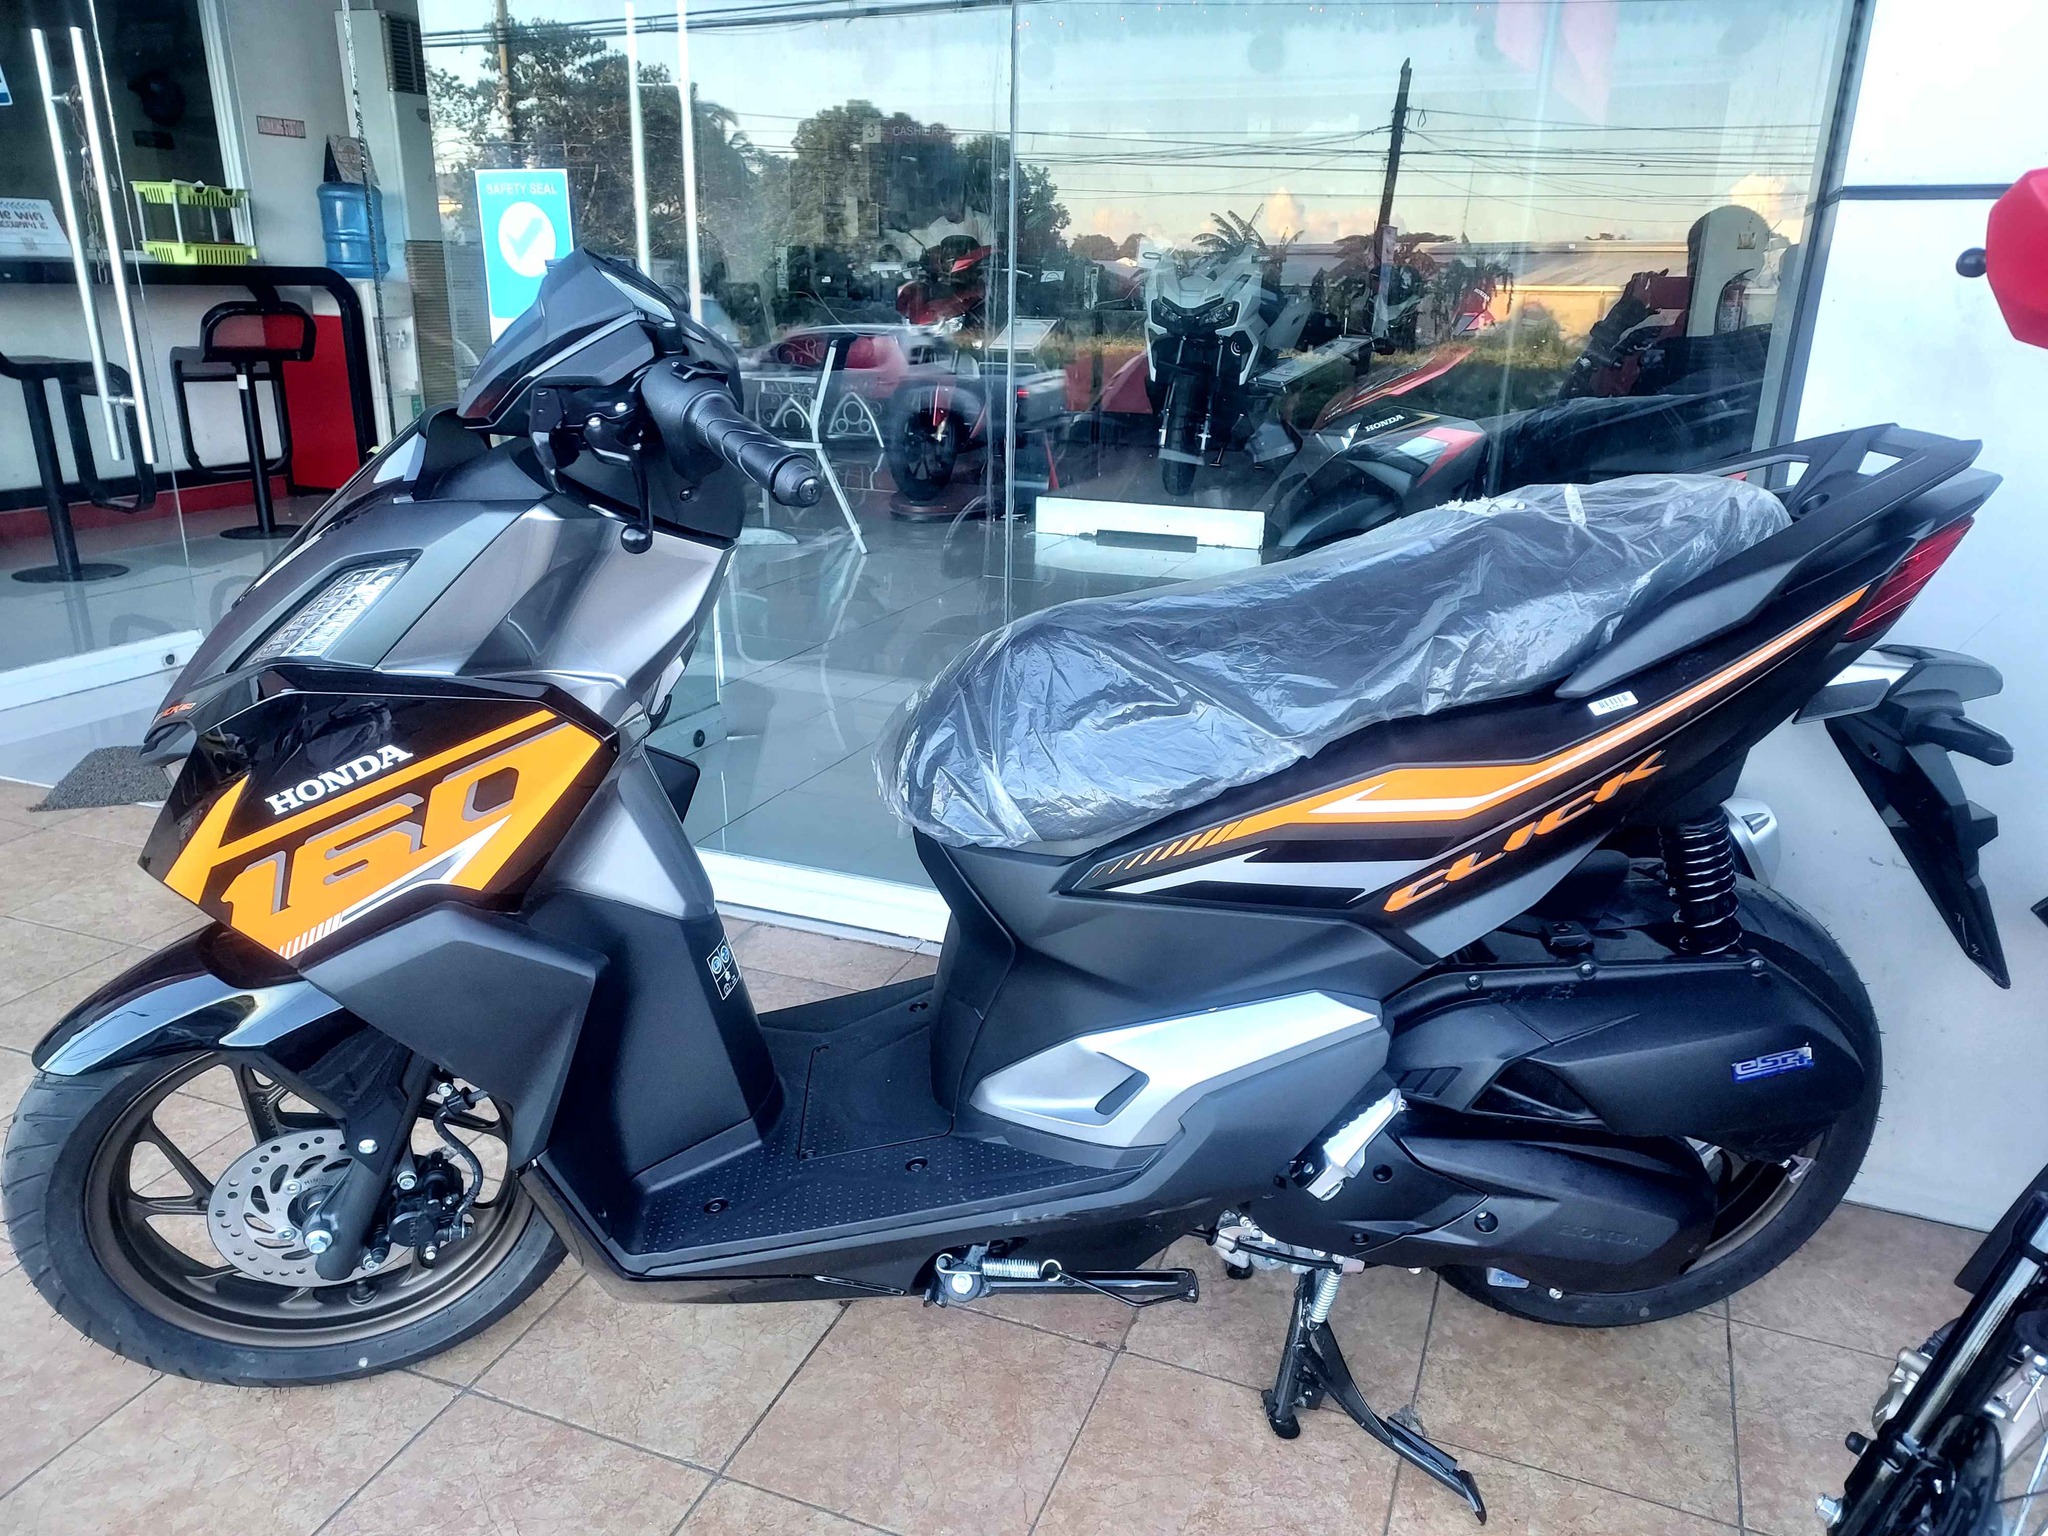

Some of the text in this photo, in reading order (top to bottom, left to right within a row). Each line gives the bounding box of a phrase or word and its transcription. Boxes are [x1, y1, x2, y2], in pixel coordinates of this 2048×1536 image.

[486, 183, 557, 195] SAFETY SEAL
[1364, 414, 1405, 433] HONDA
[264, 744, 413, 815] HONDA
[220, 766, 530, 928] 160
[1383, 750, 1667, 912] CLICK
